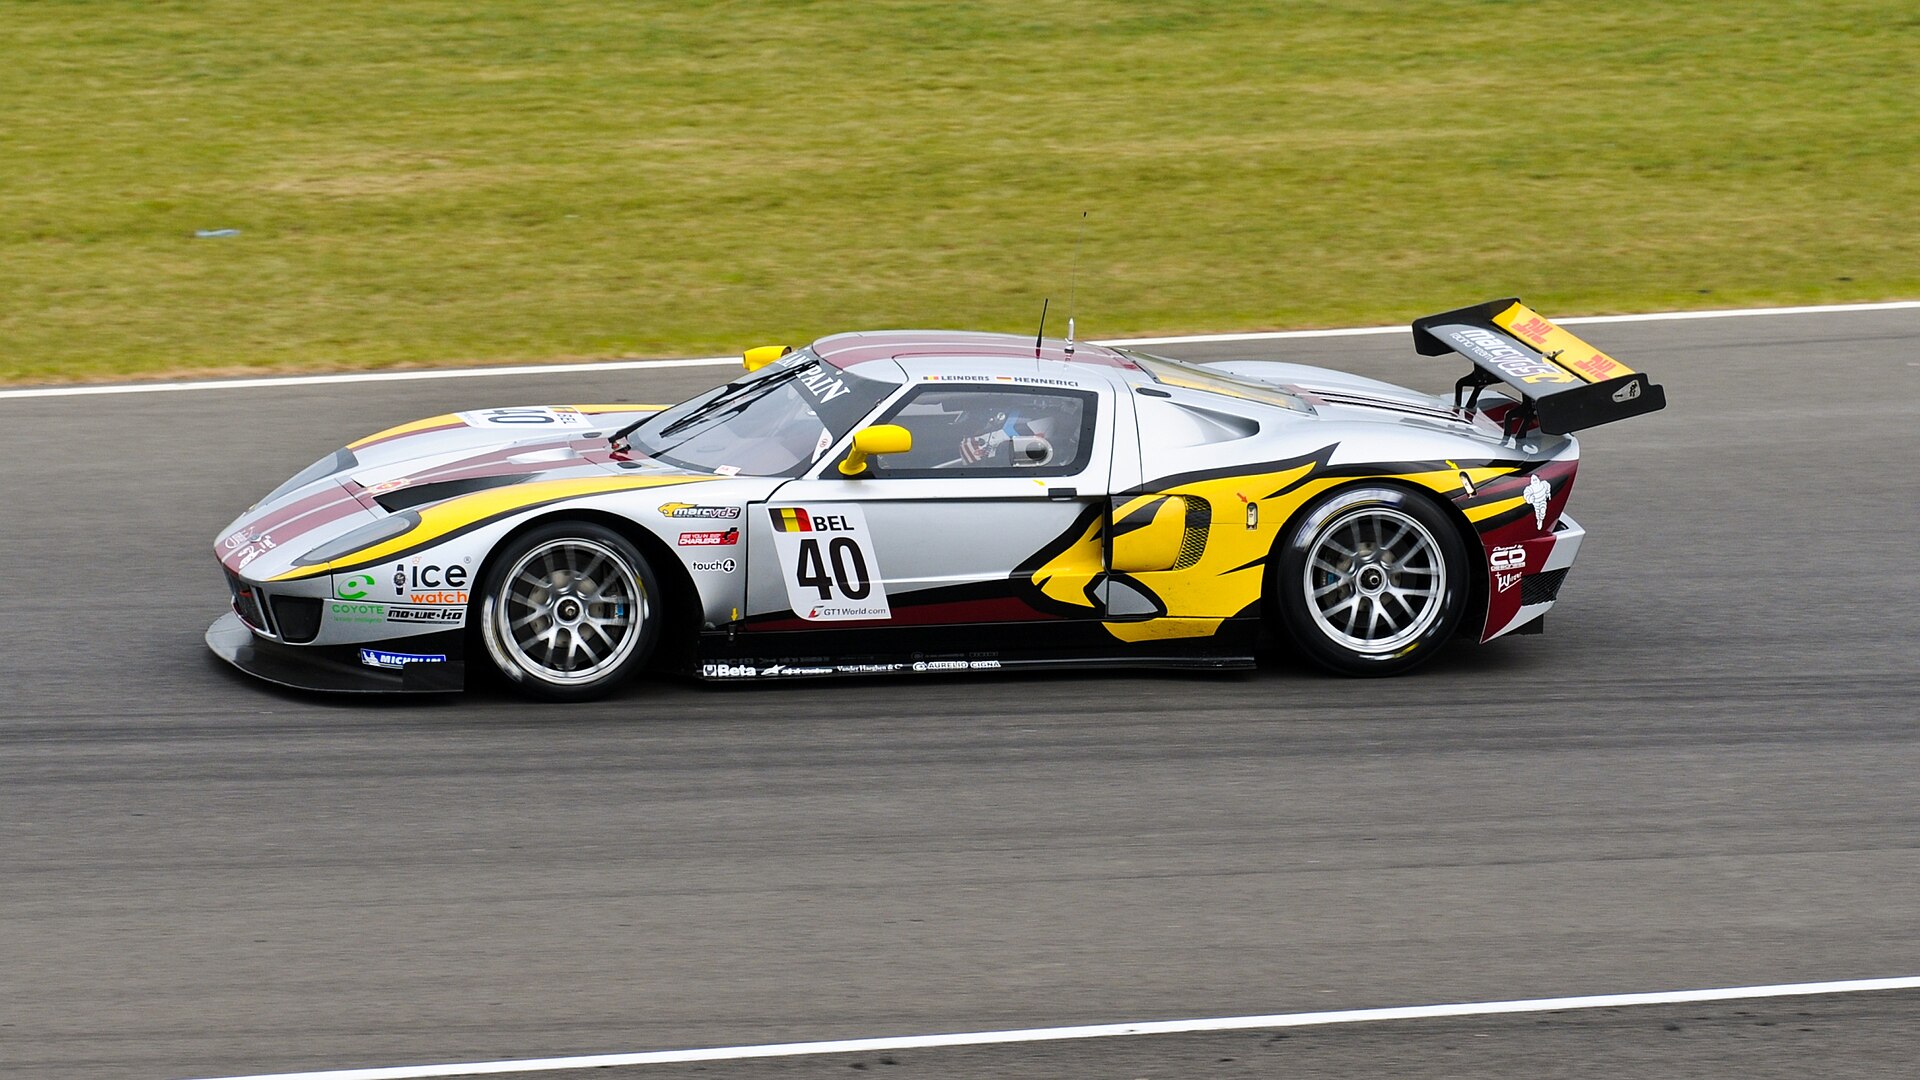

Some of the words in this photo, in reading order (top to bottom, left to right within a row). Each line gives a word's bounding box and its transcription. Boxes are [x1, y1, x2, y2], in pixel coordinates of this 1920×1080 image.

[1013, 376, 1079, 387] HENNERICI
[812, 515, 855, 532] BEL
[411, 558, 467, 588] ice
[797, 536, 872, 601] 40
[410, 591, 468, 604] watch
[332, 604, 385, 615] COYOTE
[717, 664, 757, 677] Beta
